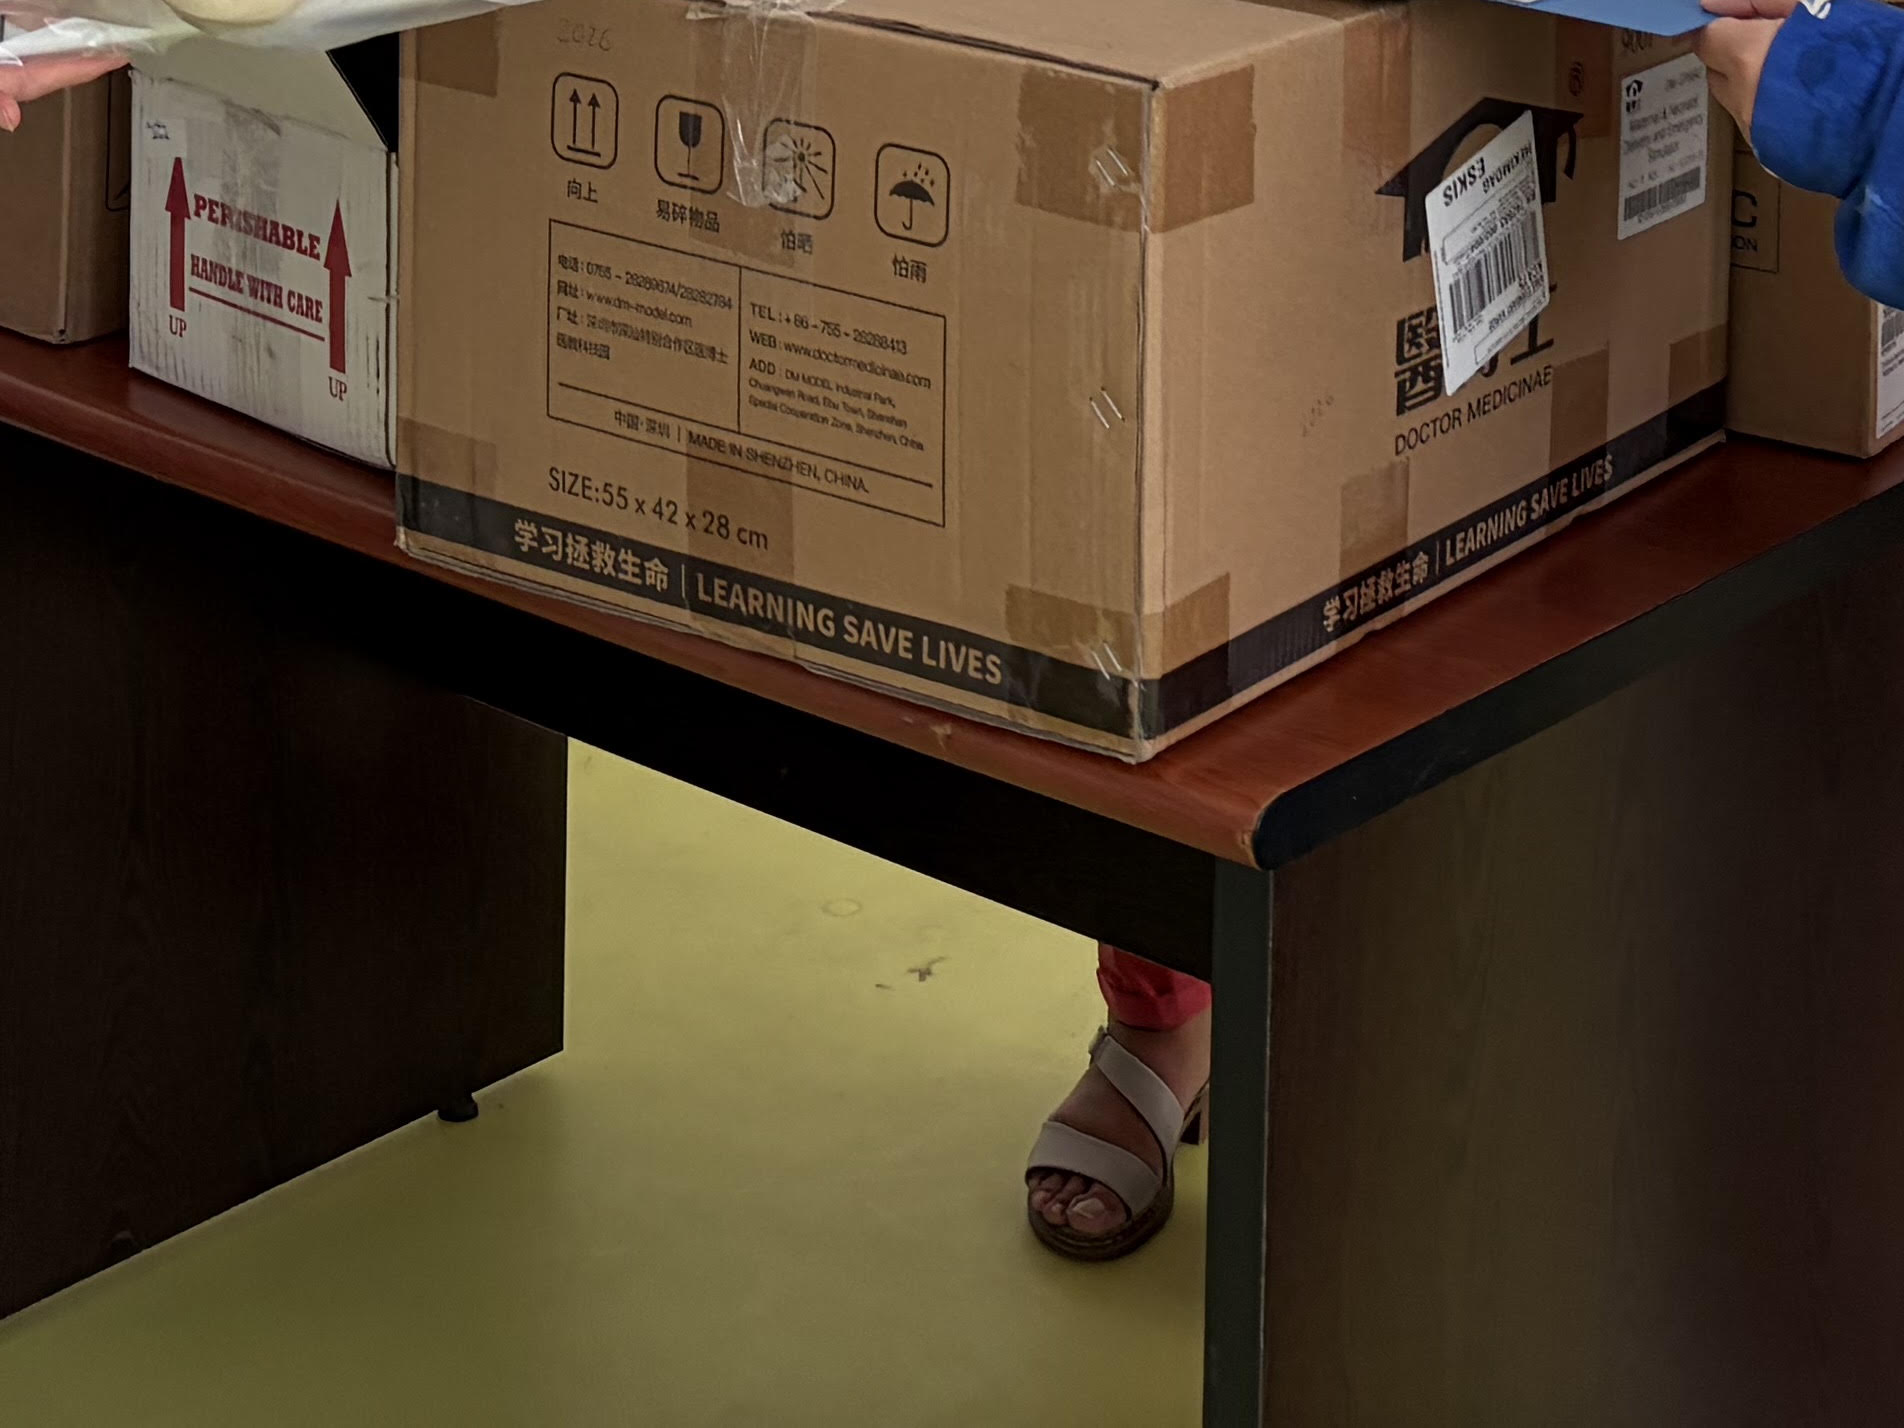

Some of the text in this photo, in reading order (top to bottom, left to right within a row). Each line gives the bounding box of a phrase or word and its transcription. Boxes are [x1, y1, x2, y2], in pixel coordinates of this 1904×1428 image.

[567, 179, 599, 204] 向上
[194, 194, 320, 261] PERISHABLE
[656, 200, 720, 233] 易碎物品
[190, 254, 323, 323] HANDLE WITH CARE
[892, 256, 928, 284] 怕雨
[169, 316, 186, 337] UP
[329, 377, 347, 401] UP
[1395, 365, 1553, 456] DOCTOR MEDICINAE
[688, 431, 727, 454] MADE
[729, 441, 742, 459] IN
[634, 496, 646, 514] x
[653, 496, 679, 525] 42
[685, 512, 696, 530] x
[702, 511, 730, 540] 28
[737, 525, 769, 550] cm
[1323, 455, 1613, 632] 学习拯救生命 LEARNING SAVE LIVES
[514, 518, 1002, 686] 学习拯救生命 LEARNING SAVE LIVES
